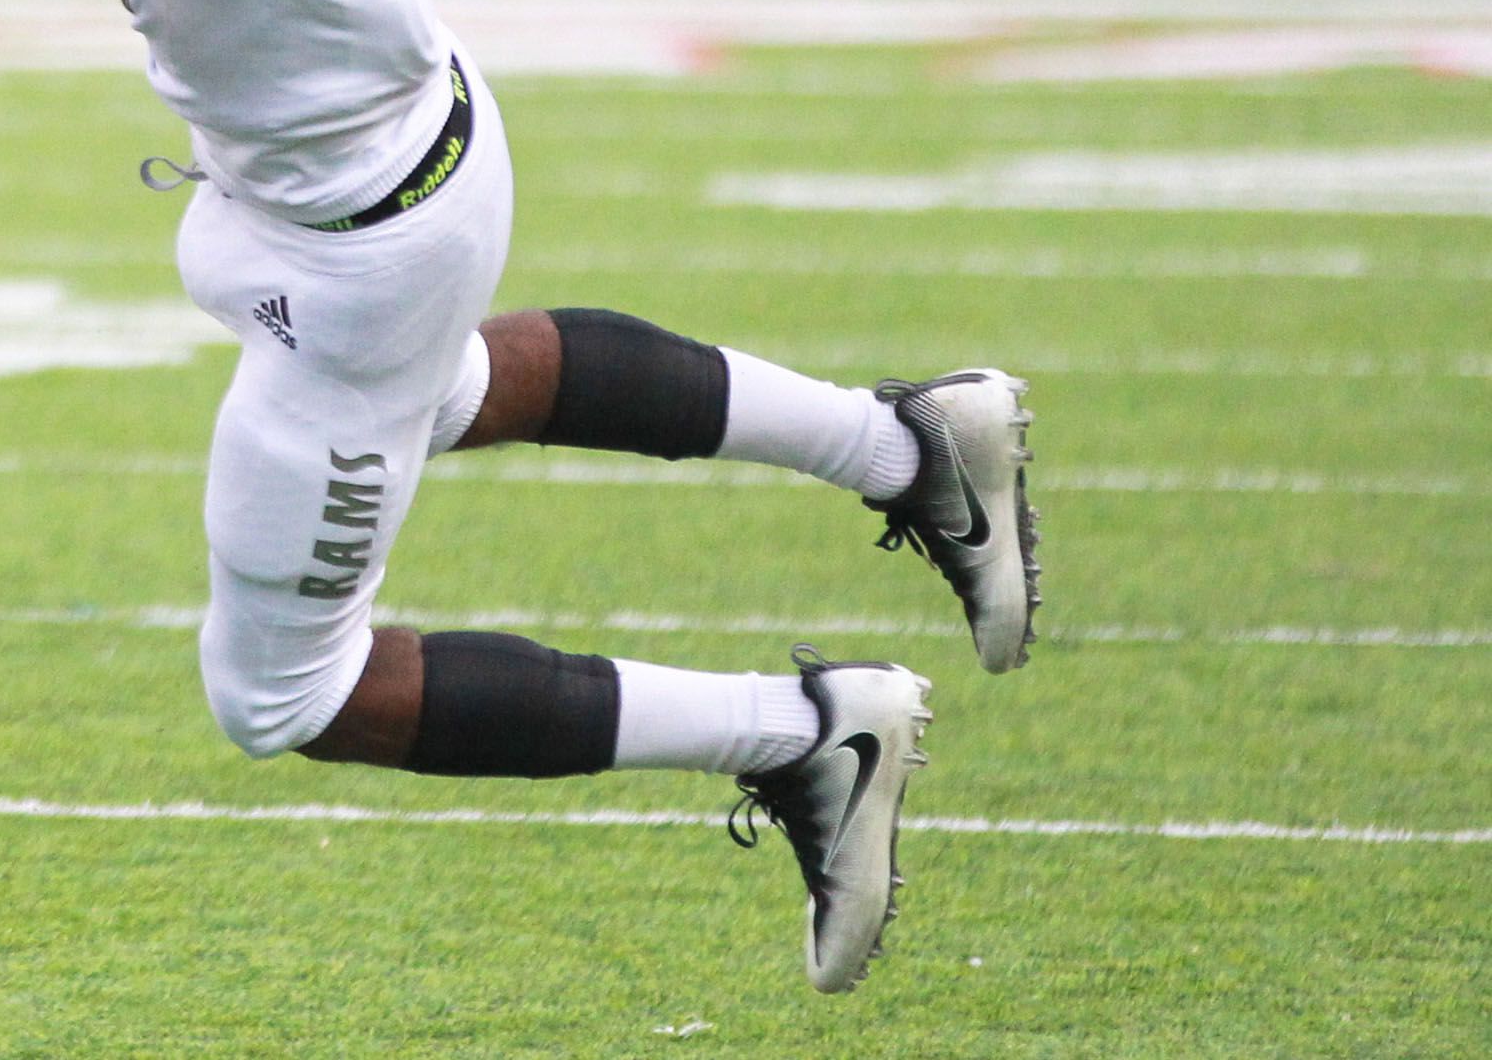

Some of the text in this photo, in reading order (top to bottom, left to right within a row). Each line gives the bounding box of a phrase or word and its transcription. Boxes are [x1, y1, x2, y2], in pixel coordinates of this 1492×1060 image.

[397, 136, 464, 210] Riddell
[252, 308, 298, 350] adidas
[298, 446, 389, 601] RAMS
